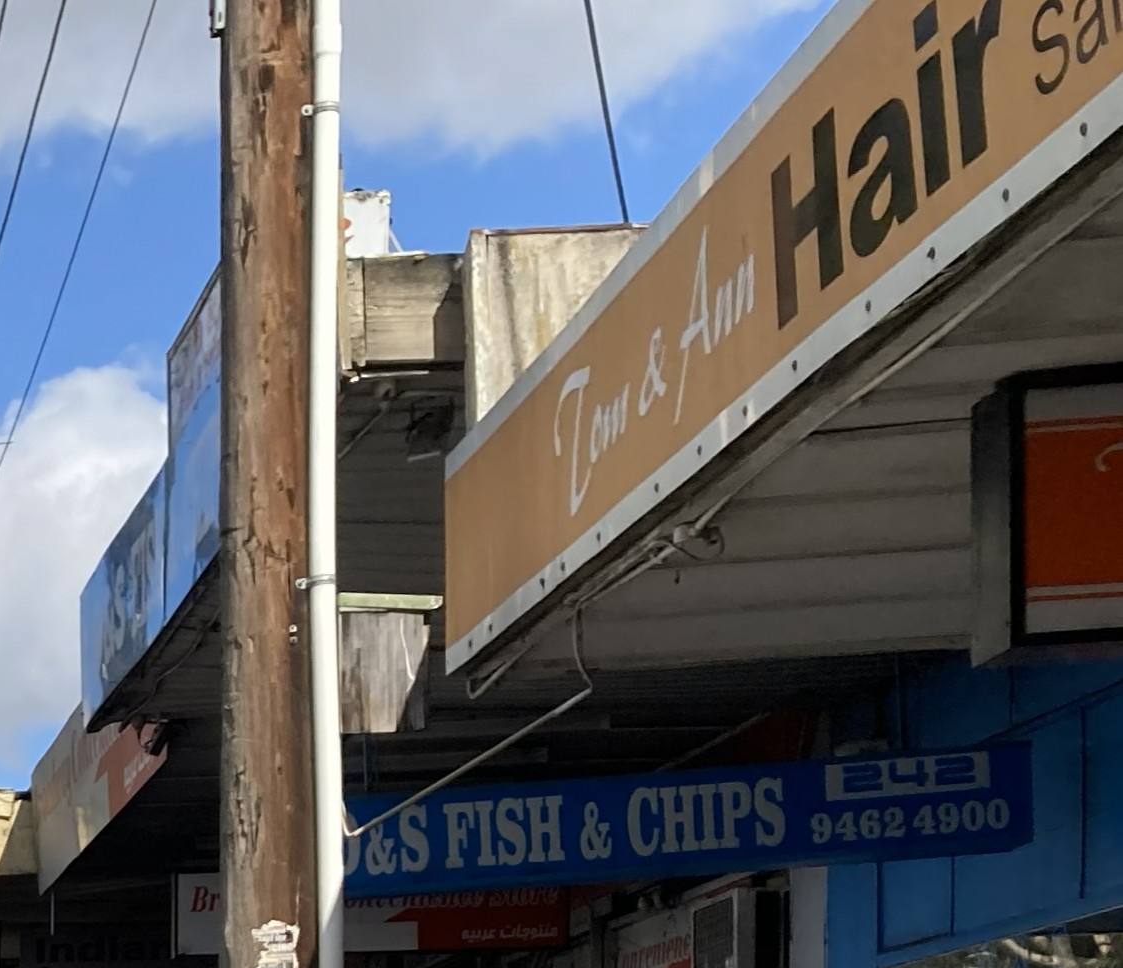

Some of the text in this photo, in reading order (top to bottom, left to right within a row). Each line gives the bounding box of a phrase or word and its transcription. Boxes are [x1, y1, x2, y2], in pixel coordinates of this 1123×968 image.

[553, 367, 628, 516] Tom
[638, 327, 667, 417] &
[674, 225, 755, 425] Ann
[770, 0, 1002, 330] Hair
[841, 755, 980, 795] 242
[444, 794, 565, 868] FISH
[581, 801, 612, 860] &
[627, 777, 786, 858] CHIPS
[810, 799, 1011, 844] 9462 4900
[191, 886, 219, 912] Br
